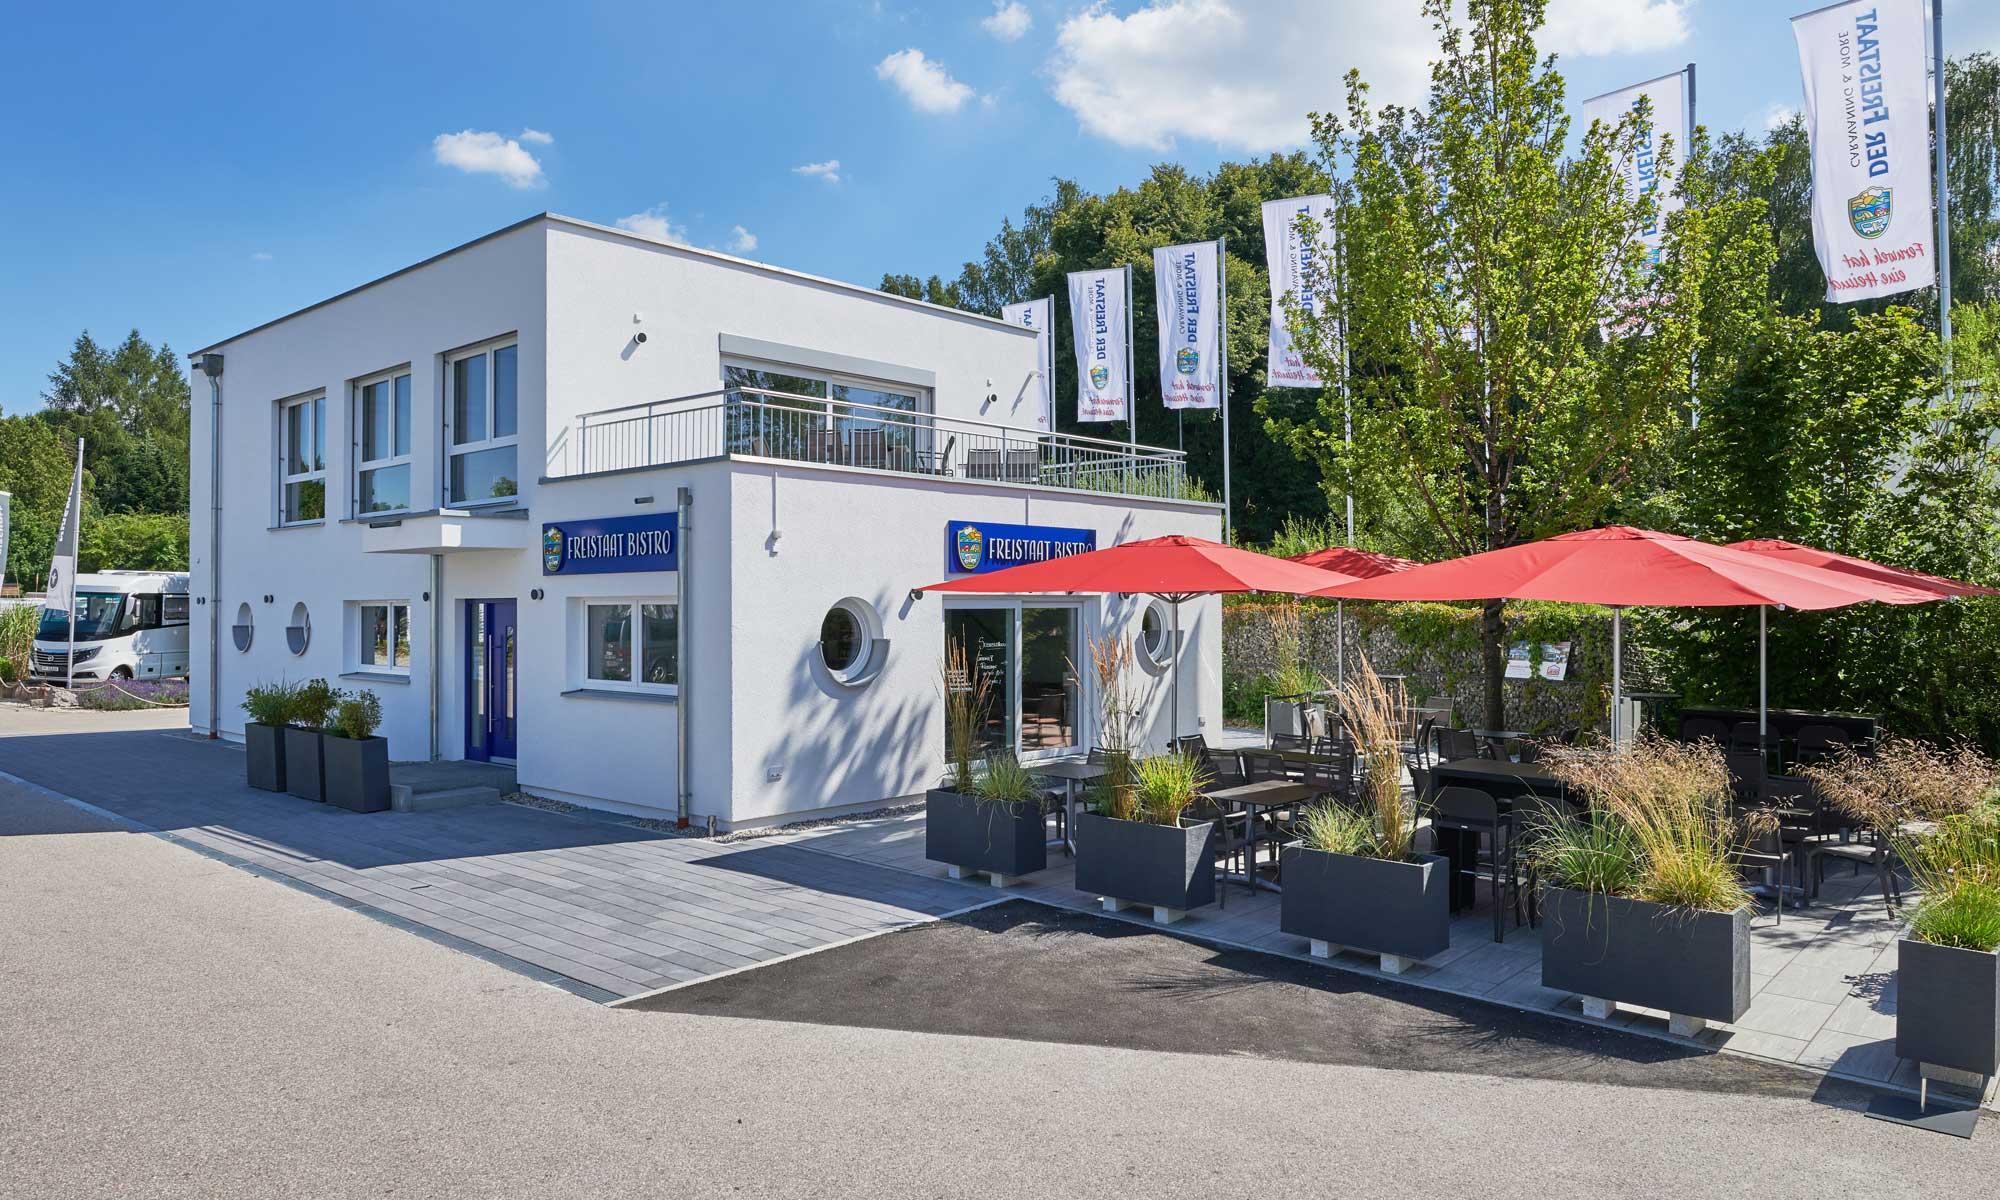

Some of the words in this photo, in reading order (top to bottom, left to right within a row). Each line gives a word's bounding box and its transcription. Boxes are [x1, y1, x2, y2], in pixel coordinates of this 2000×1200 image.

[567, 533, 624, 560] FREISTAAT
[628, 530, 671, 556] BISTRO
[989, 537, 1050, 561] FREISTAAT
